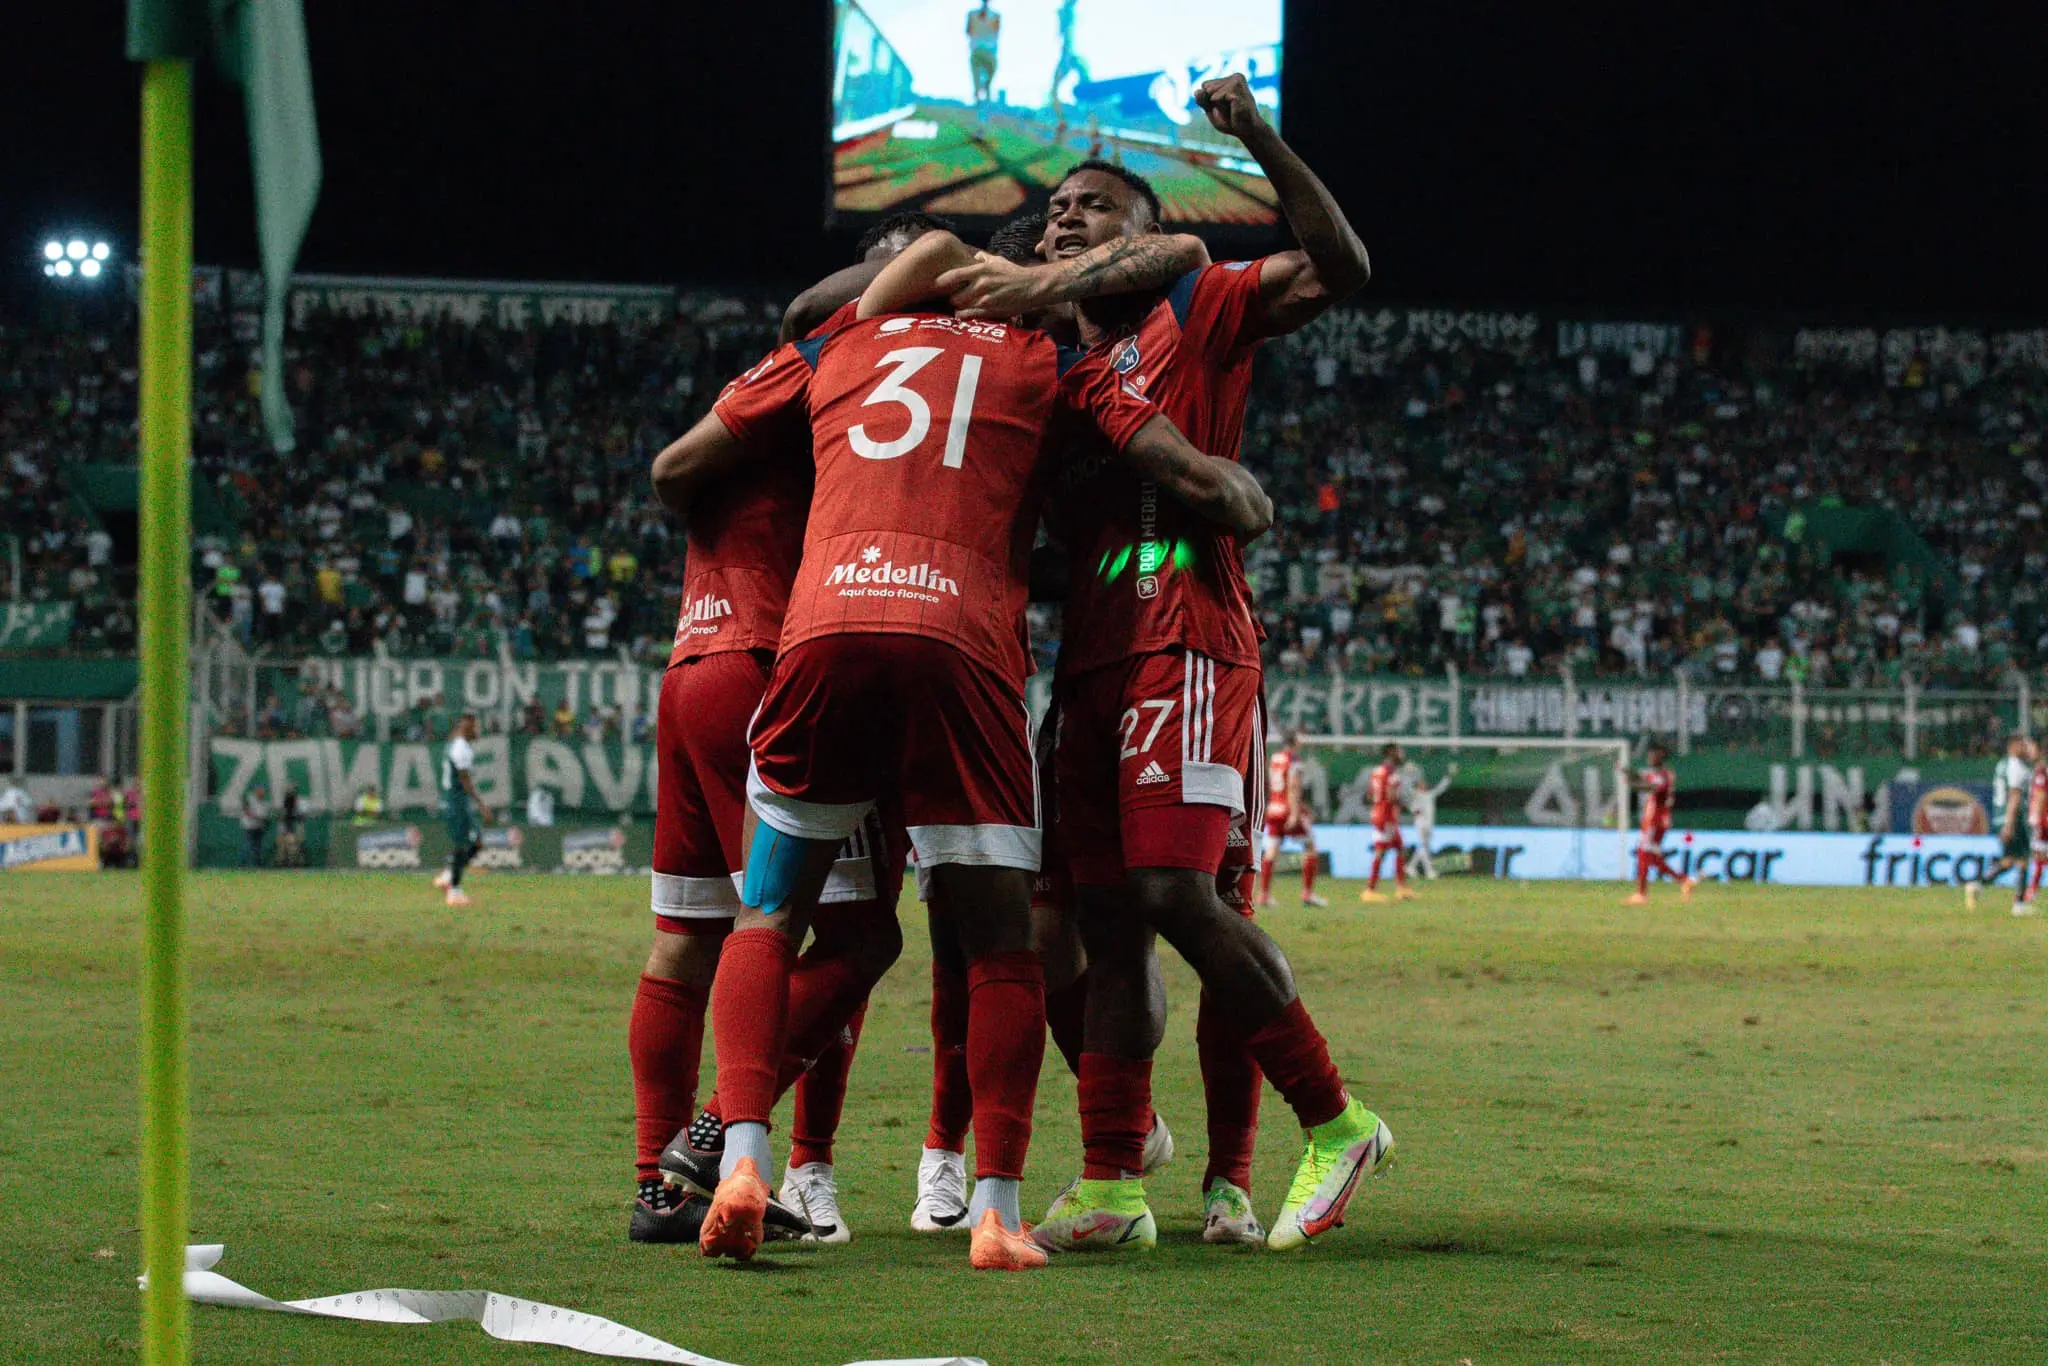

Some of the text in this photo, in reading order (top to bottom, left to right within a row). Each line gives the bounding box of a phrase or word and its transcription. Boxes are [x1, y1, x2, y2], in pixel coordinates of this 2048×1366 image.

[848, 346, 983, 469] 31
[1139, 542, 1156, 573] RON
[824, 560, 959, 596] Medellín
[838, 588, 940, 603] Aquí todo florece
[463, 660, 538, 711] ON
[1119, 699, 1176, 760] 27
[1136, 774, 1170, 785] adidas
